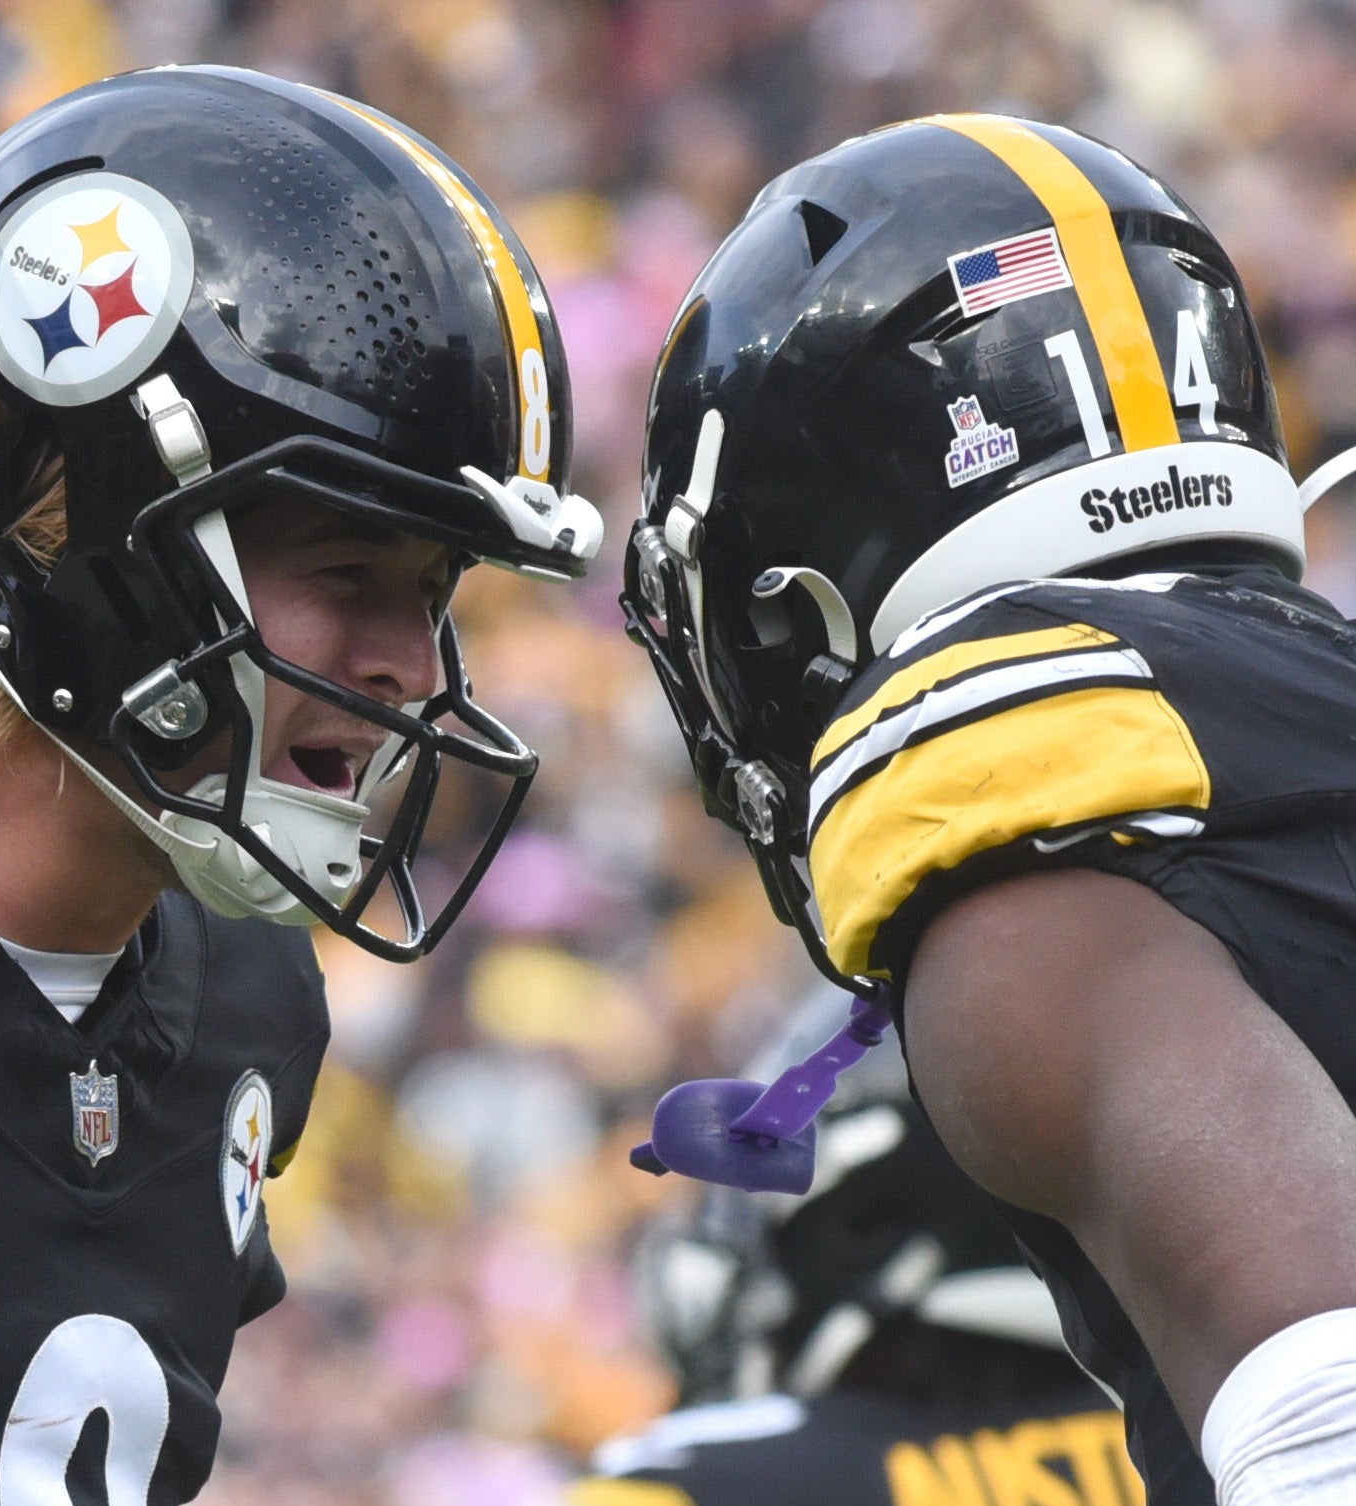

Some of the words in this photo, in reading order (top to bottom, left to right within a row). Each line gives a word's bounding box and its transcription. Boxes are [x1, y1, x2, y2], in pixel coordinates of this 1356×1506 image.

[9, 245, 70, 286] Steelers
[521, 347, 551, 476] 8
[958, 411, 979, 428] NFL
[948, 431, 1015, 474] CATCH
[953, 427, 1000, 451] CRUCIAL
[951, 464, 987, 484] INTERCEPT
[990, 453, 1017, 469] CANCER
[1079, 464, 1234, 534] Steelers
[81, 1110, 111, 1144] NFL
